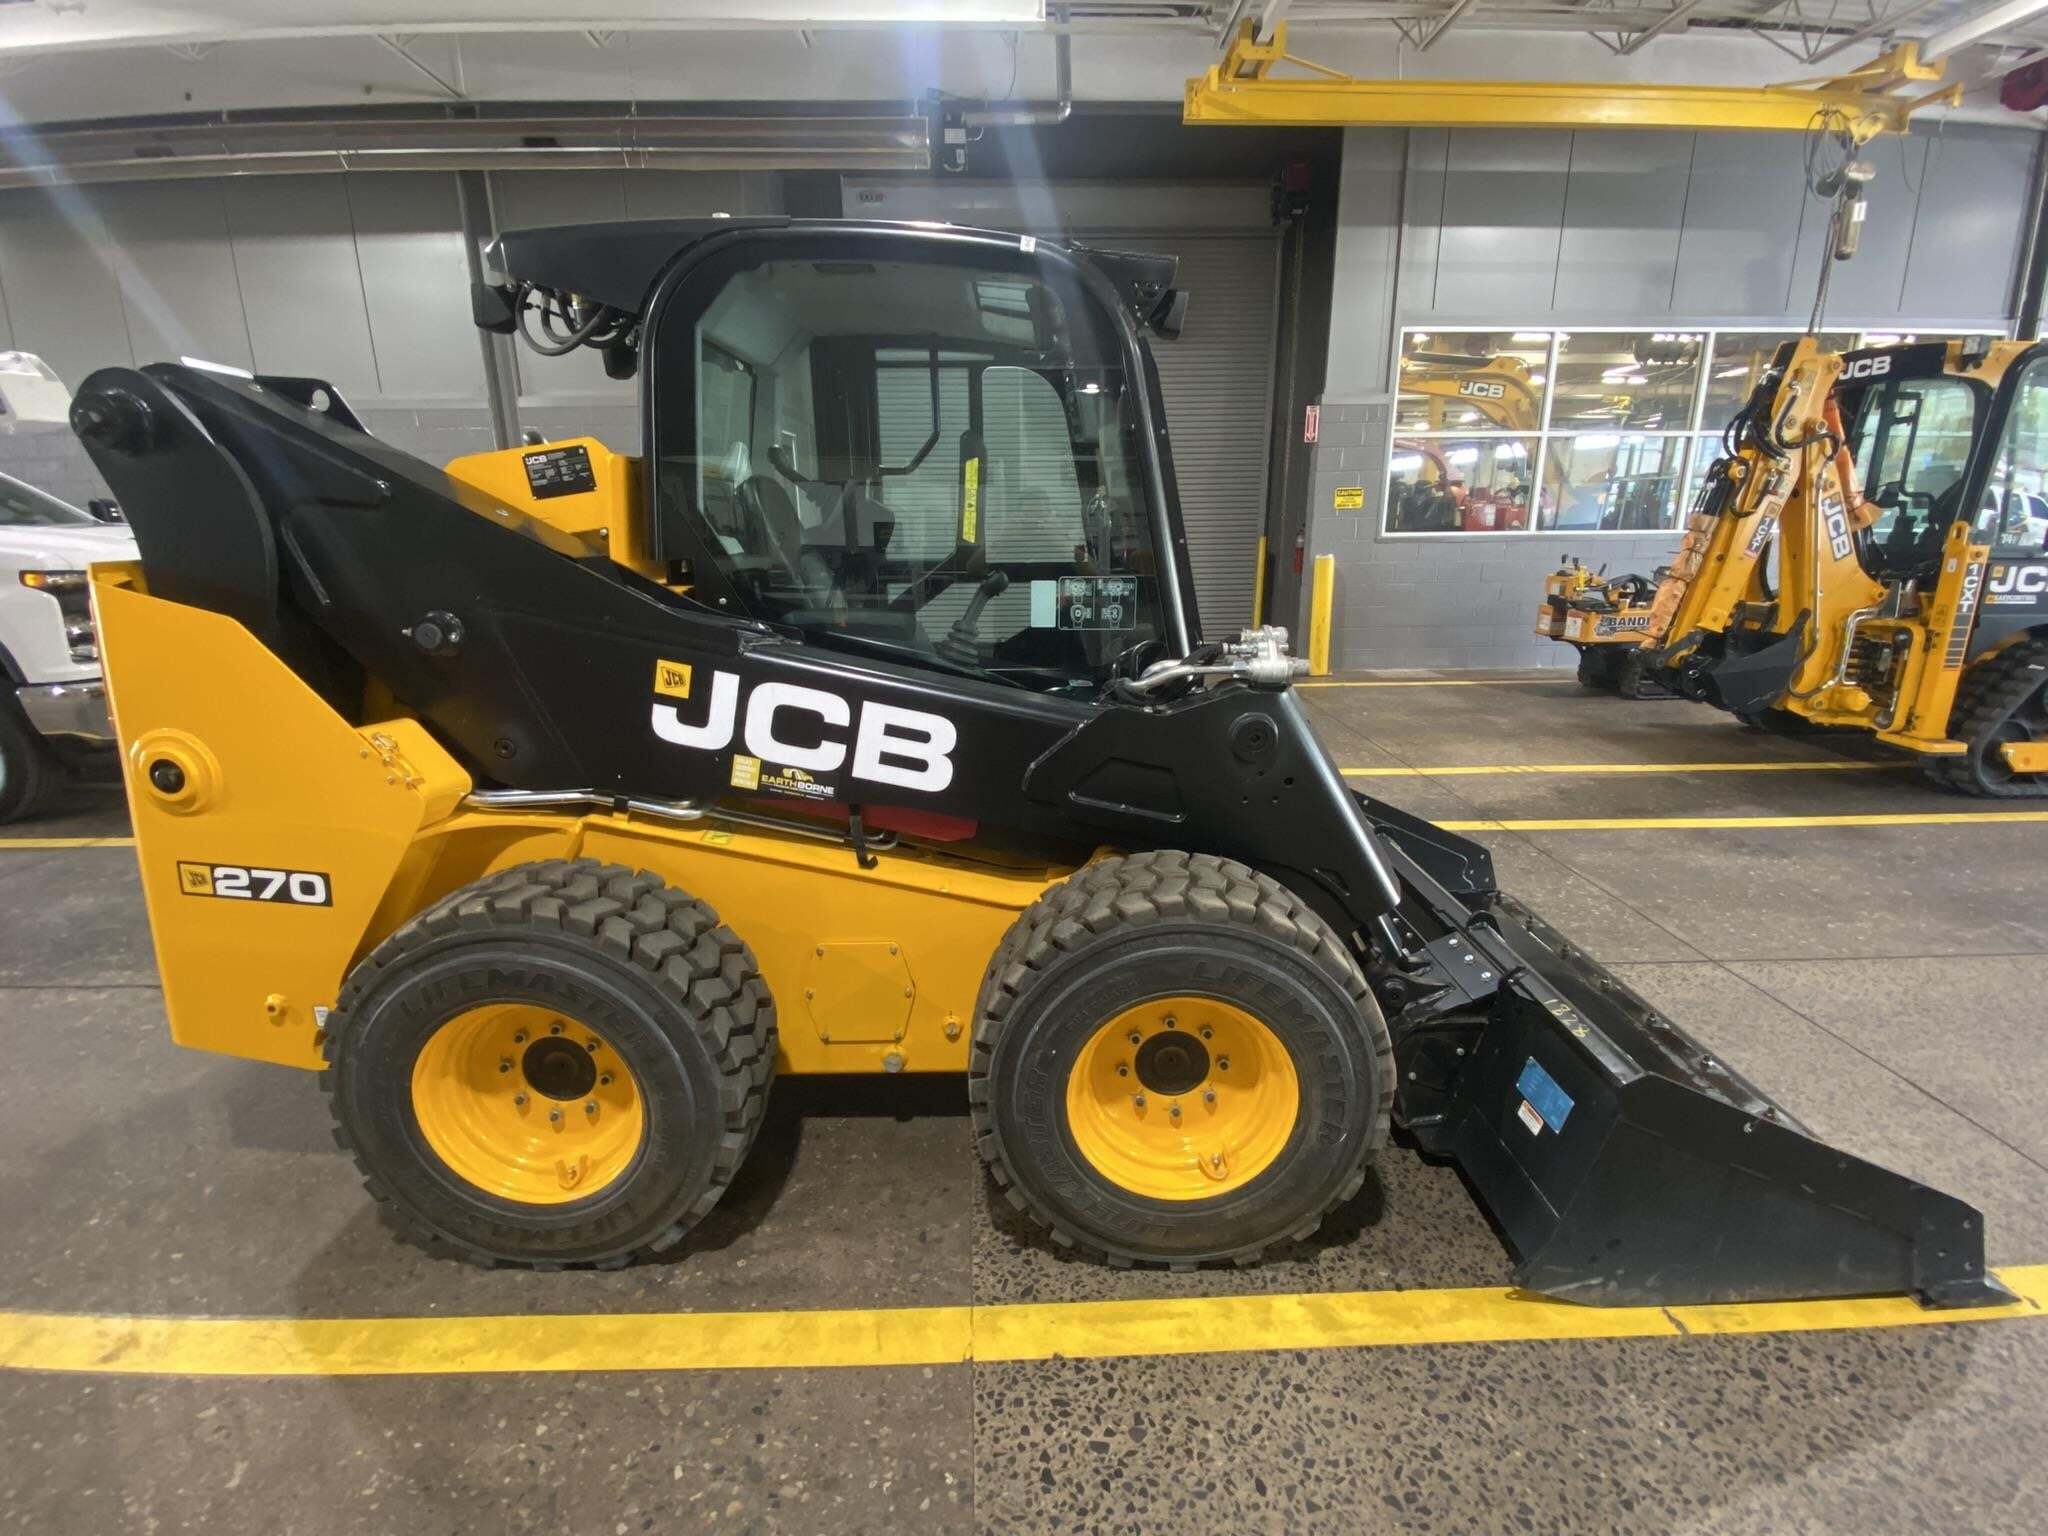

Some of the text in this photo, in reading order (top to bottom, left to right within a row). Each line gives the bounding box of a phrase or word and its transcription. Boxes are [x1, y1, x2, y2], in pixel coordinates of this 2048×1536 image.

[1839, 356, 1891, 380] JCB
[1459, 381, 1505, 399] JCB
[525, 455, 547, 465] JCB
[1822, 498, 1852, 559] JCB
[1960, 563, 1979, 612] 1CXT
[1989, 566, 2048, 593] JC
[1611, 617, 1650, 627] BANDI
[664, 668, 686, 688] JCB
[651, 670, 957, 792] JCB
[761, 774, 835, 795] EARTHBORNE
[213, 866, 326, 903] 270
[1193, 960, 1348, 1145] LIFEMASTER
